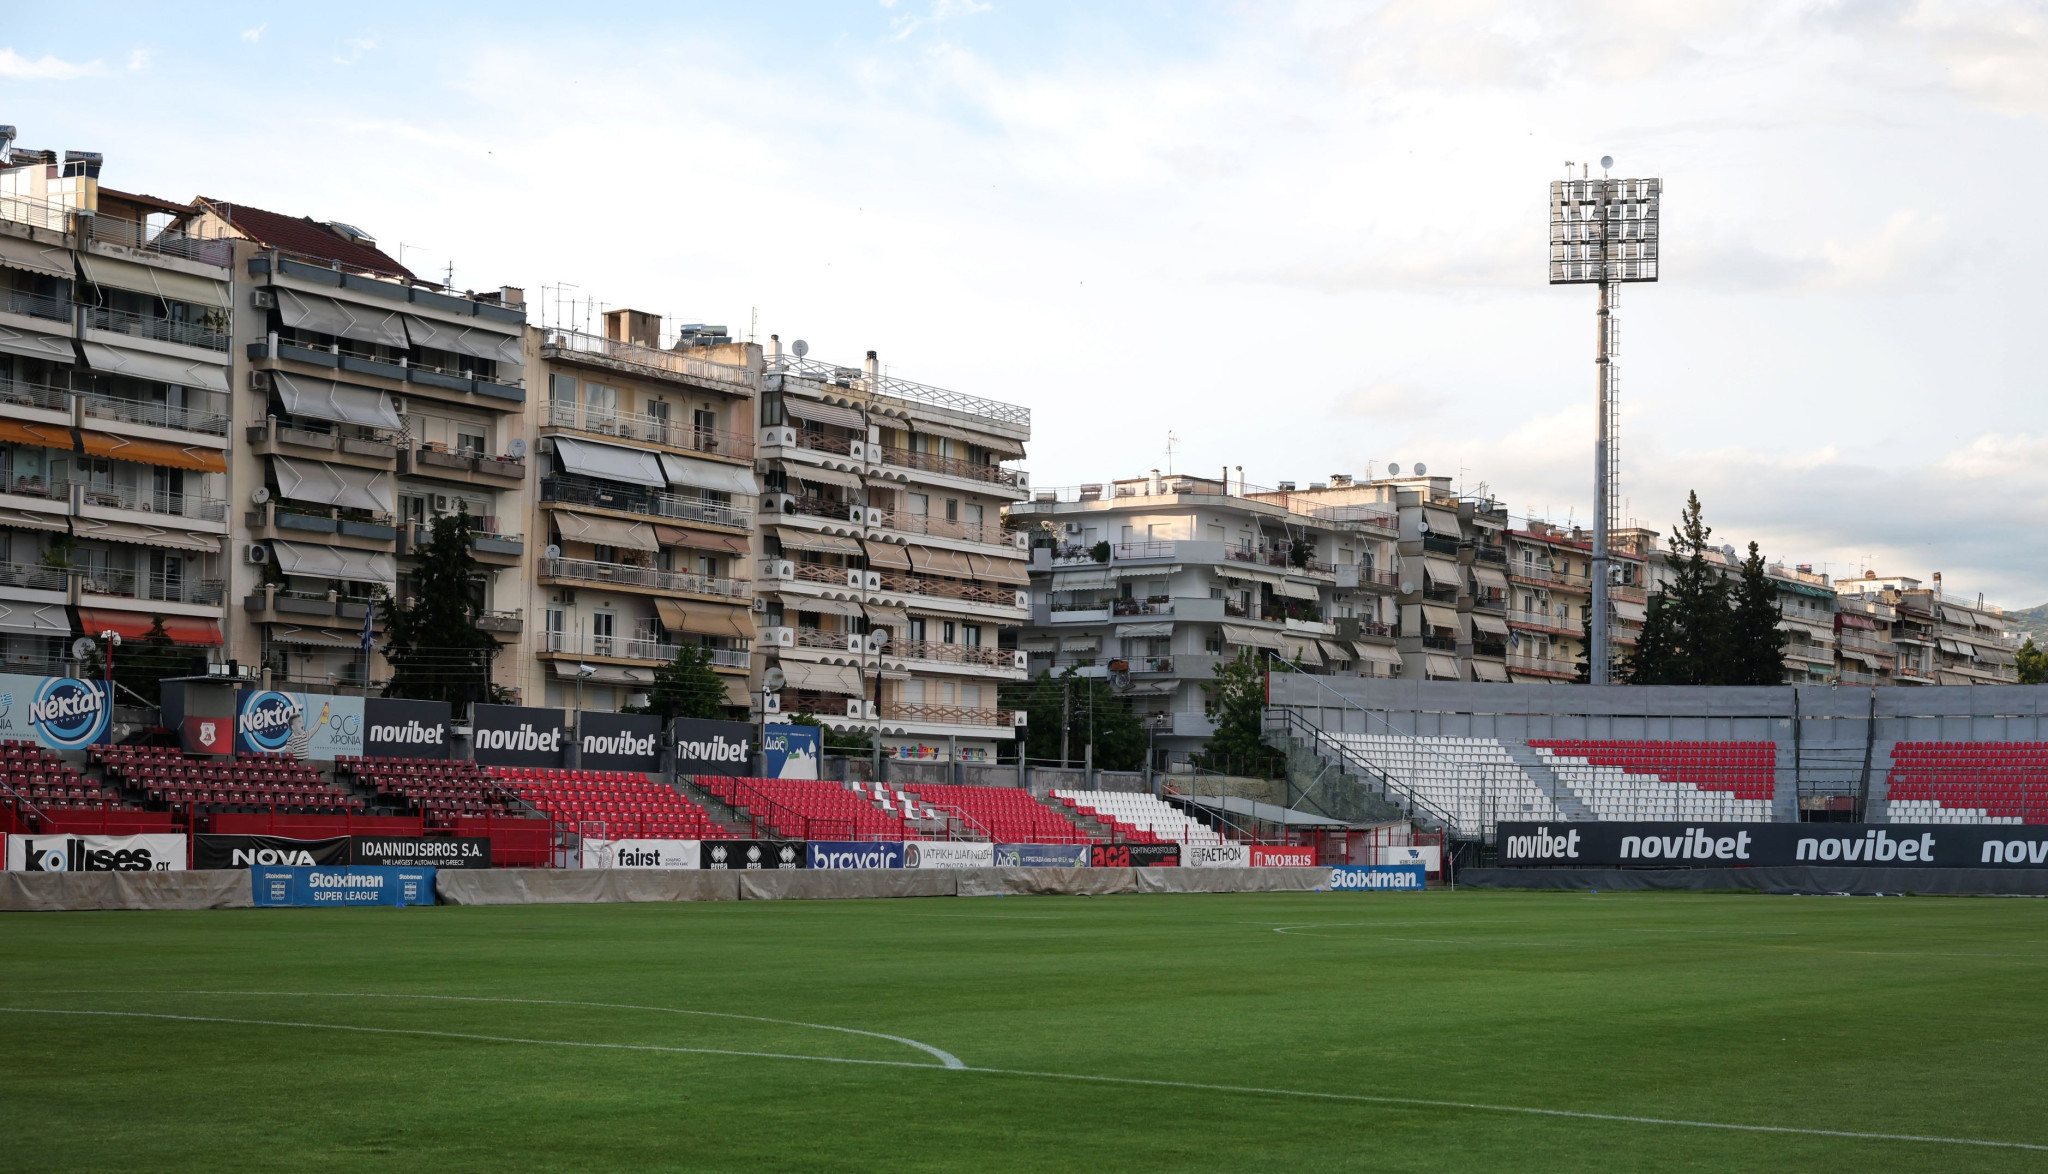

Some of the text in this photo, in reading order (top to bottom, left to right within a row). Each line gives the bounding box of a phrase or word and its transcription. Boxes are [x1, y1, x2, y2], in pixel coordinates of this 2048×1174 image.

[330, 735, 361, 745] ΧΡΟΝΙΑ
[370, 720, 444, 744] novibet
[476, 723, 561, 752] novibet
[583, 730, 656, 756] novibet
[678, 735, 749, 762] novibet
[362, 842, 483, 857] IOANNIDISBROS S.A.
[1507, 827, 1581, 858] novibet
[1620, 828, 1752, 859] novibet
[1796, 830, 1936, 861] novibet
[1981, 841, 2048, 863] nov
[232, 849, 316, 866] NOVA
[618, 848, 660, 866] fairst
[814, 845, 897, 868] bravair
[924, 849, 992, 860] ΙΑΤΡΙΚΗ ΔΙΑΓΝΩΣΗ
[1092, 846, 1130, 867] aca
[1202, 847, 1241, 861] FAETHON
[1264, 854, 1311, 867] MORRIS
[310, 872, 383, 888] Stoiximan
[1331, 868, 1416, 888] Stoiximan
[314, 892, 378, 901] SUPER LEAGUE
